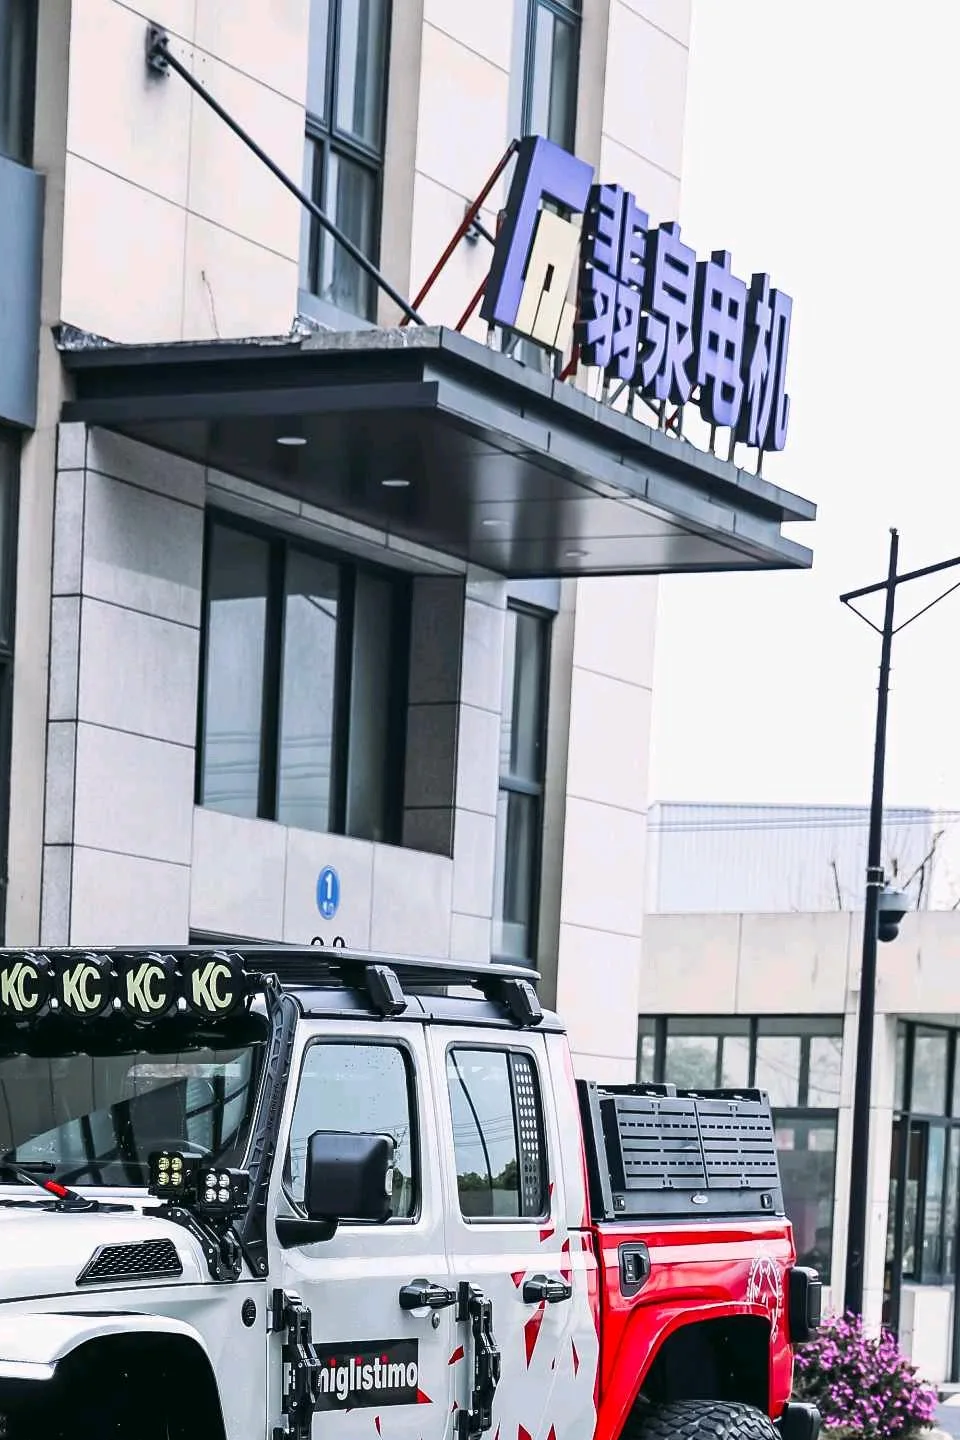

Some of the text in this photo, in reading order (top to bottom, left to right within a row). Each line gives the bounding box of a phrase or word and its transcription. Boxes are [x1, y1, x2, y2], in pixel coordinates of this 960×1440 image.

[0, 963, 38, 1008] KC
[63, 963, 101, 1009] KC
[127, 963, 165, 1009] KC
[192, 962, 232, 1008] KC
